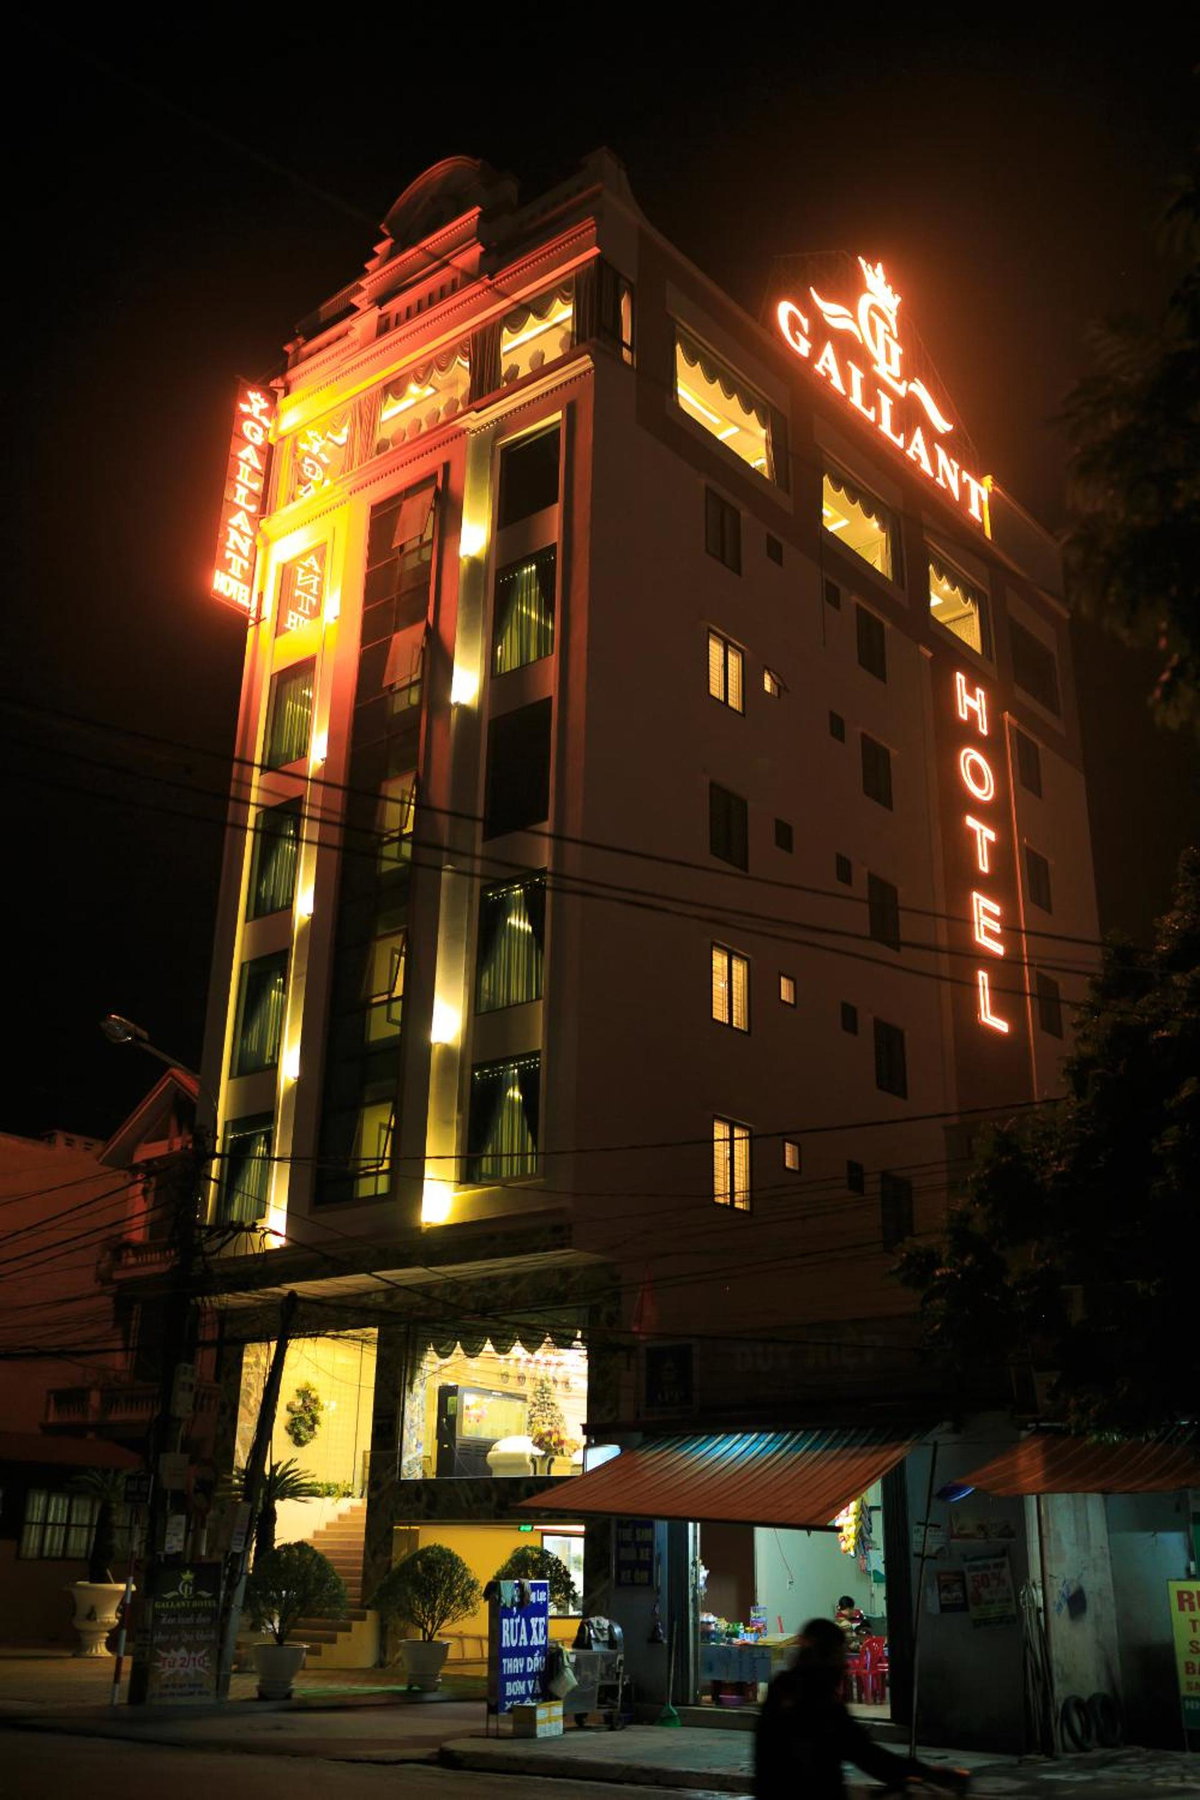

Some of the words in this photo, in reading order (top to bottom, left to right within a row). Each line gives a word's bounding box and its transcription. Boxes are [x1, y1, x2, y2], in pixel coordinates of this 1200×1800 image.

[777, 300, 989, 523] GALLANT
[223, 421, 266, 579] GALLANT
[213, 568, 252, 608] HOTEL
[955, 671, 1009, 1033] HOTEL
[1177, 1590, 1200, 1612] R
[530, 1617, 547, 1645] XE
[502, 1657, 525, 1675] THAY
